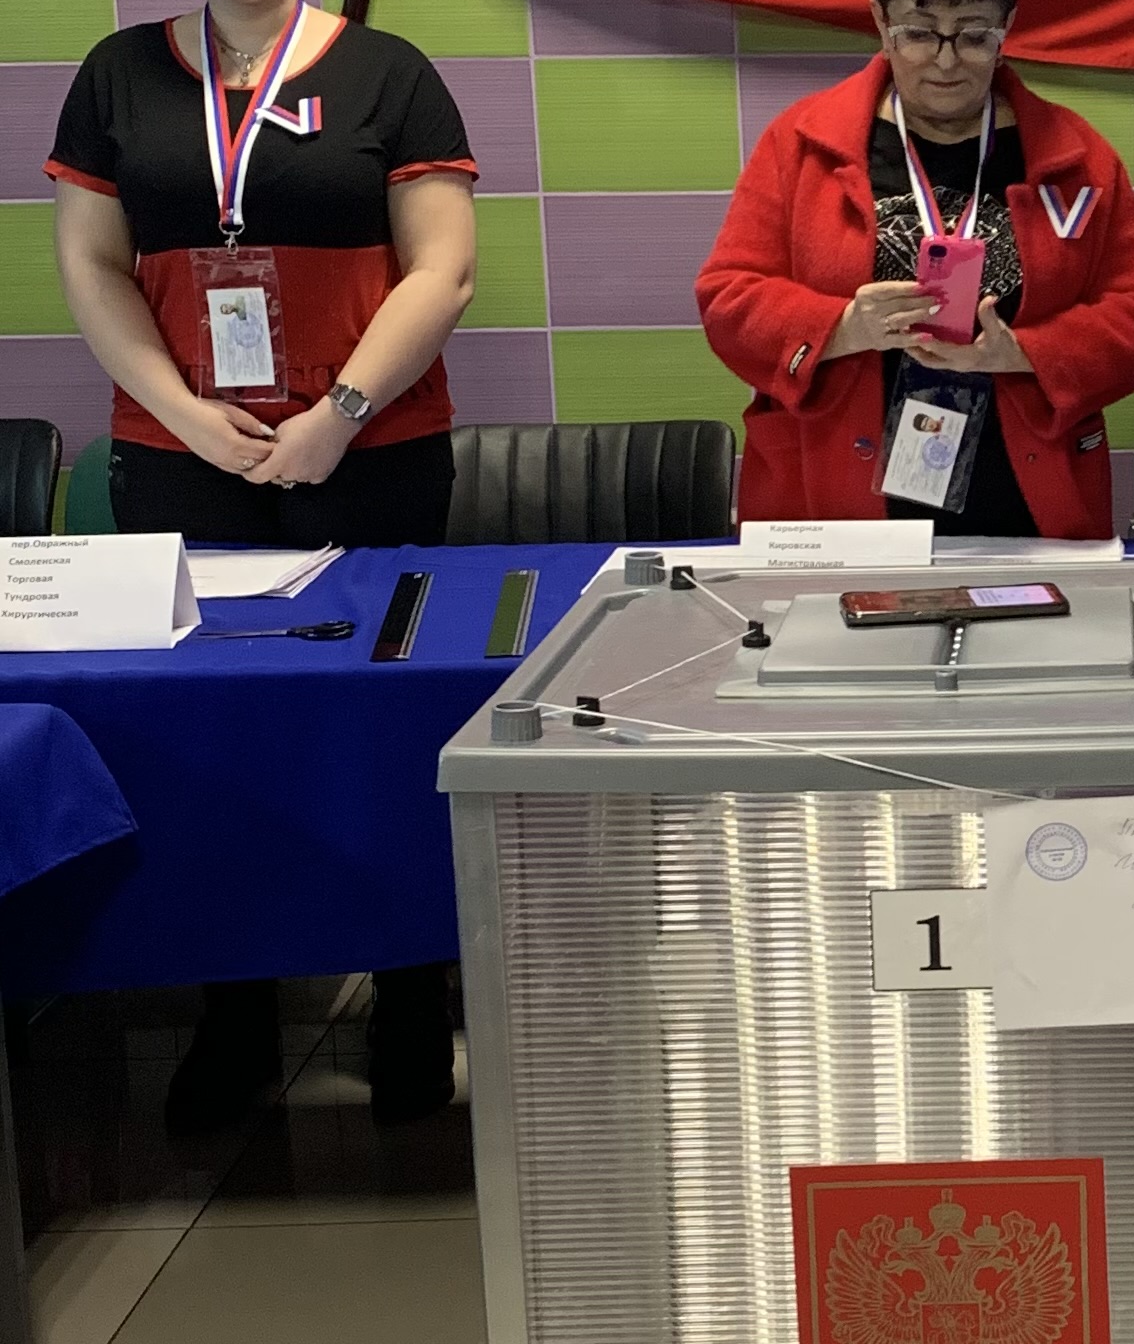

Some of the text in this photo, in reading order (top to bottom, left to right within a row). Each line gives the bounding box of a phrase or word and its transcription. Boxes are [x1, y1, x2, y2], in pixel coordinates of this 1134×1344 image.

[11, 538, 89, 549] пер.Овражный
[768, 541, 822, 551] Кировская
[8, 557, 71, 566] Смоленская
[767, 559, 845, 568] Магистральная
[7, 575, 53, 584] Торговая
[4, 592, 60, 602] Тундровая
[1, 610, 79, 620] Хирургическая
[916, 915, 952, 971] 1
